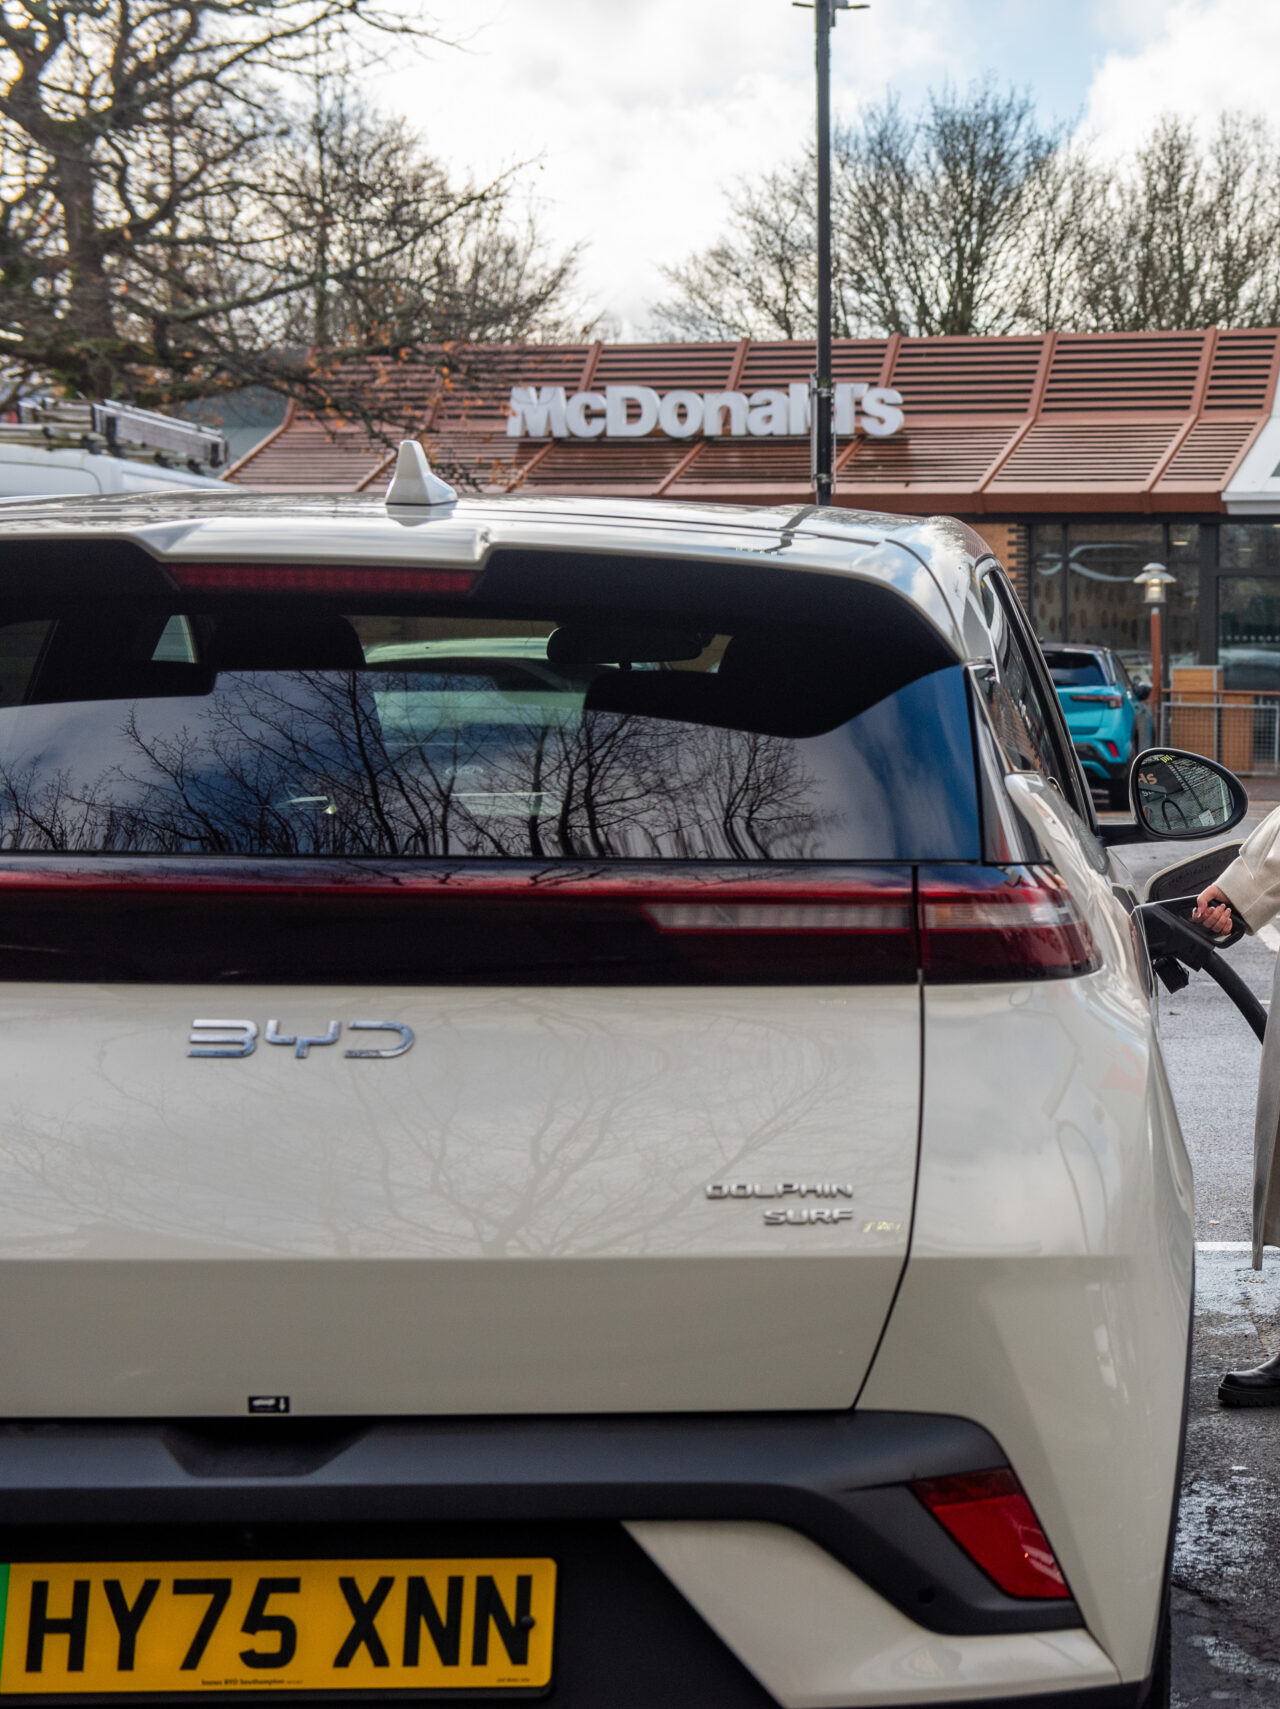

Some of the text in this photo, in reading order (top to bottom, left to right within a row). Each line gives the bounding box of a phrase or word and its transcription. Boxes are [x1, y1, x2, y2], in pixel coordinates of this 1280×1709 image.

[187, 1019, 415, 1059] BYD
[706, 1183, 854, 1200] DOLPHIN
[763, 1208, 854, 1226] SURF
[24, 1574, 535, 1674] HY75 XNN
